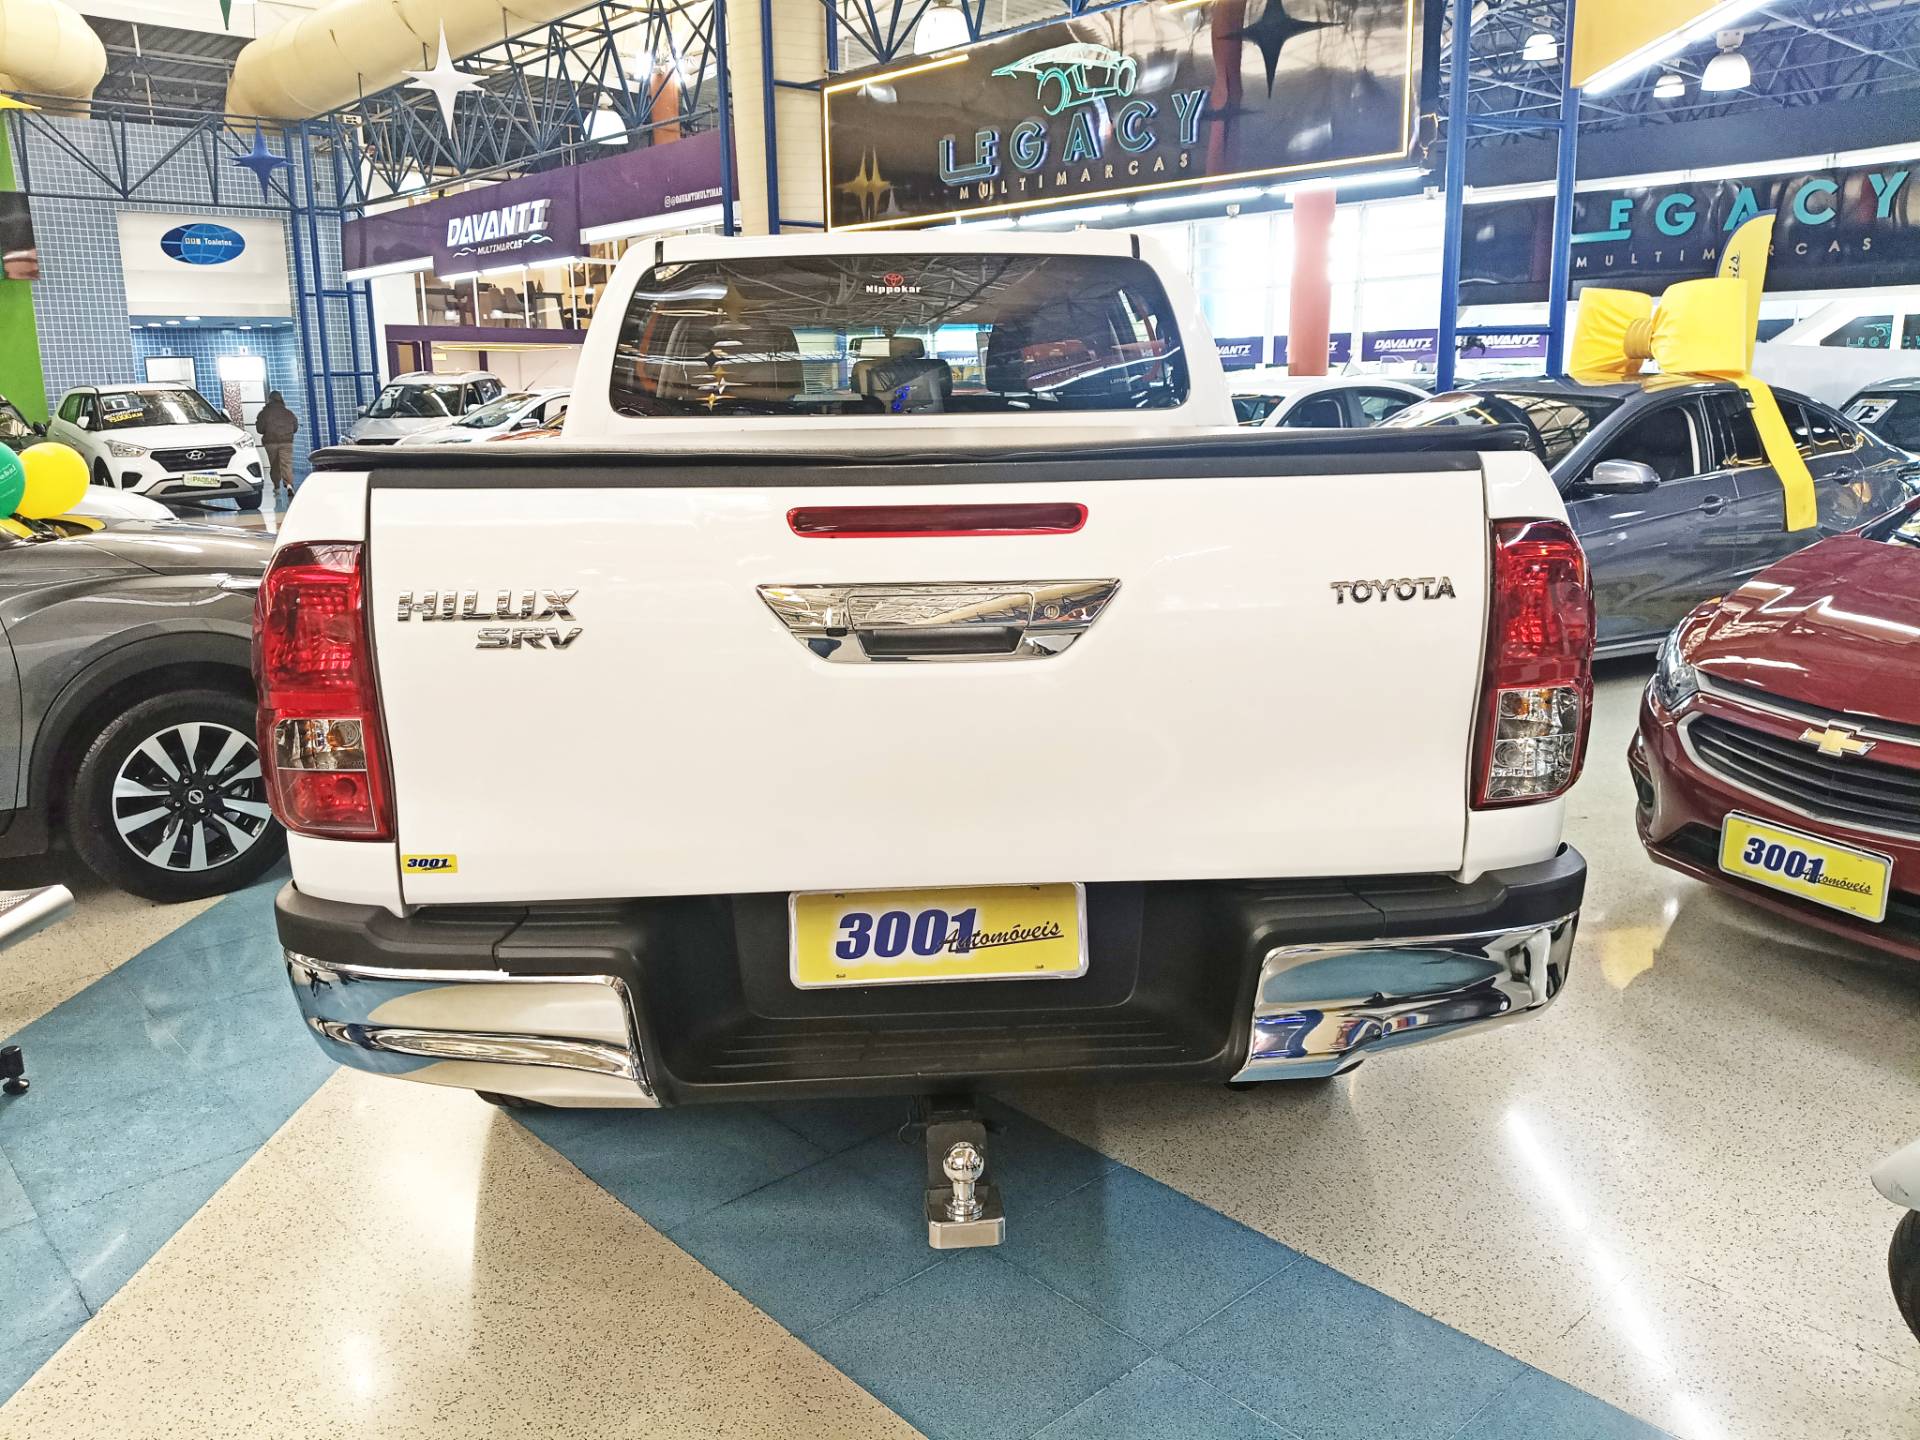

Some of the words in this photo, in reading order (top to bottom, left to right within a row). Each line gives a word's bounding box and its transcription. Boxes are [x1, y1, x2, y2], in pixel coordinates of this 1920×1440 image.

[938, 88, 1208, 184] LEGACY
[959, 152, 1189, 200] MULTIMARCAS
[446, 198, 552, 248] DAVANTI
[477, 239, 524, 256] MULTIMARCAS
[1576, 237, 1872, 269] MULTIMRCAS
[865, 284, 922, 295] Nippokar
[1374, 337, 1434, 350] DAVANTI
[397, 589, 579, 622] HILUX
[1329, 576, 1456, 605] TOYOTA
[475, 627, 583, 650] SRV
[407, 858, 448, 868] 3001
[1743, 837, 1824, 885] 3001
[835, 908, 977, 960] 3001
